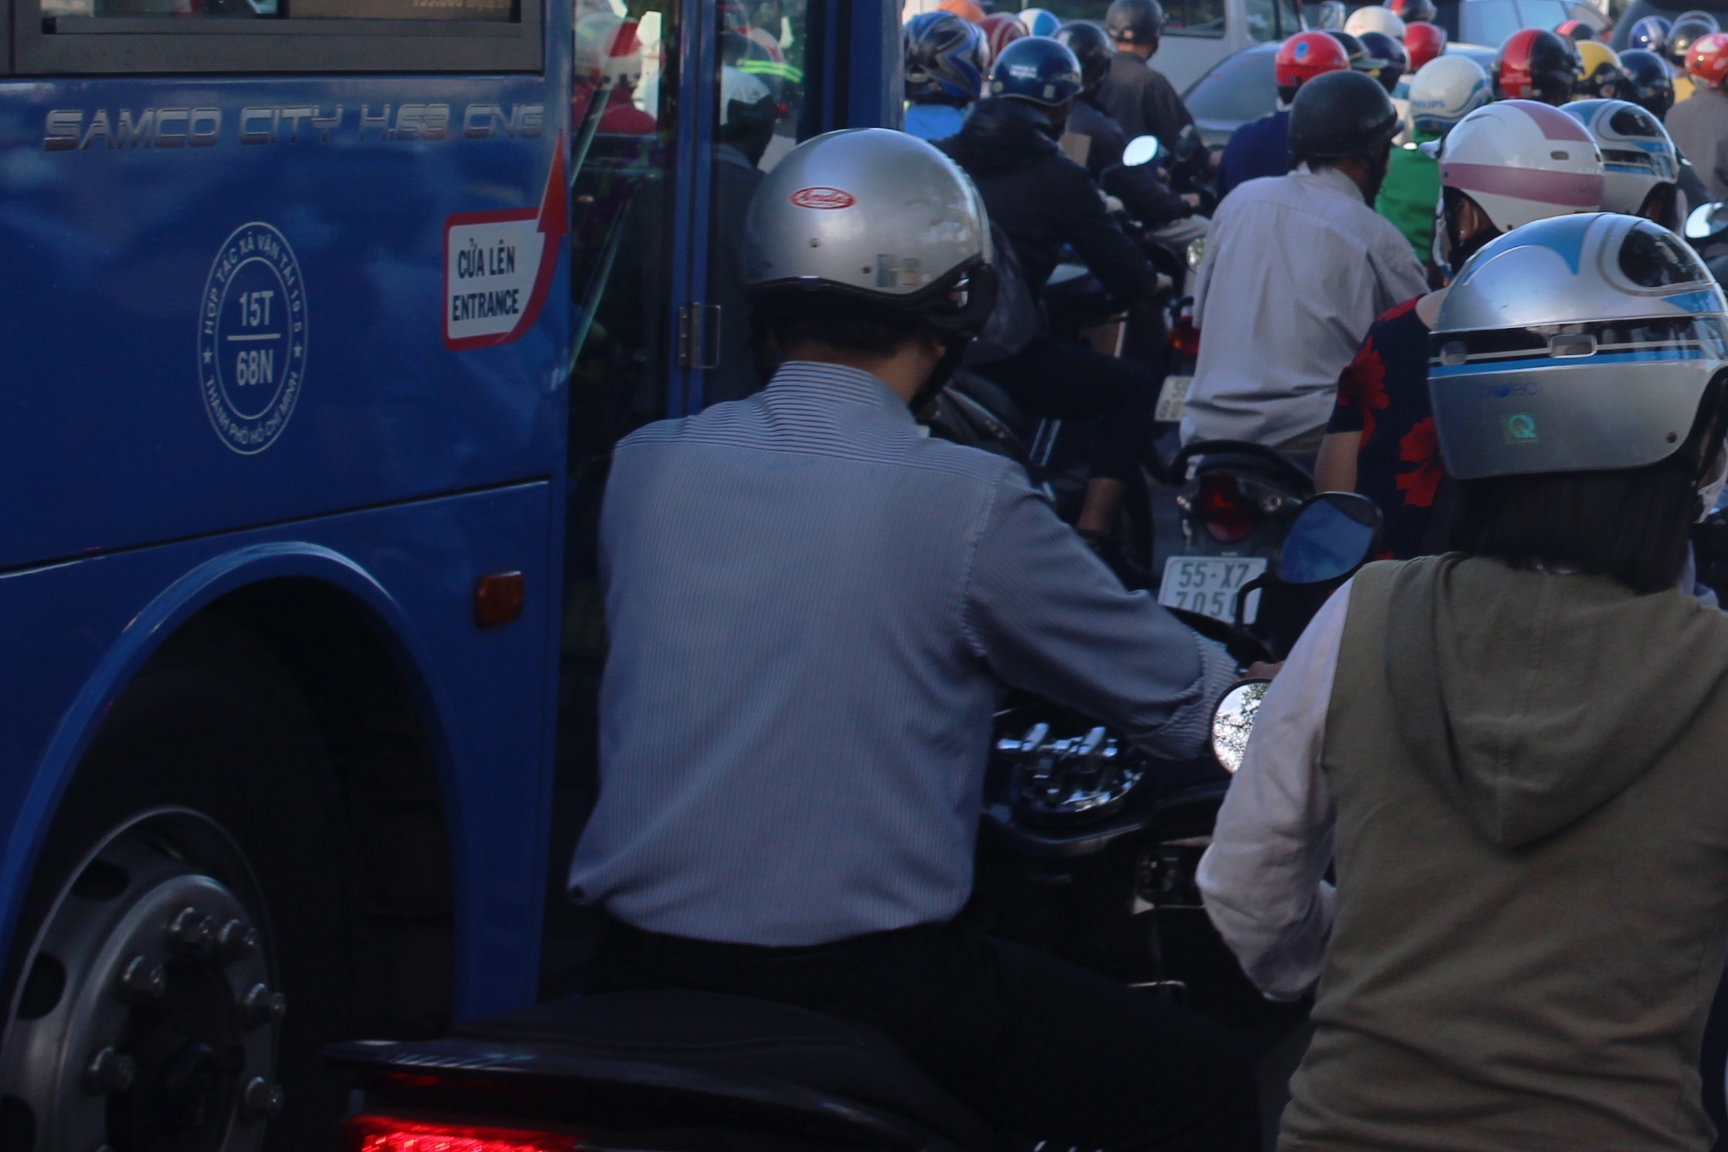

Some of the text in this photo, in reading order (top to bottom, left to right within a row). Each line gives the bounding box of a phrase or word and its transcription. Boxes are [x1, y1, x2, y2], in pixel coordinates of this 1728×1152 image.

[44, 107, 222, 151] SAMCO
[239, 104, 344, 145] CITY
[463, 103, 545, 140] CNG
[457, 237, 516, 279] CỬA LÊN
[239, 290, 275, 327] 15T
[452, 288, 520, 322] ENTRANCE
[236, 348, 274, 386] 68N
[1178, 562, 1249, 588] 55-X7
